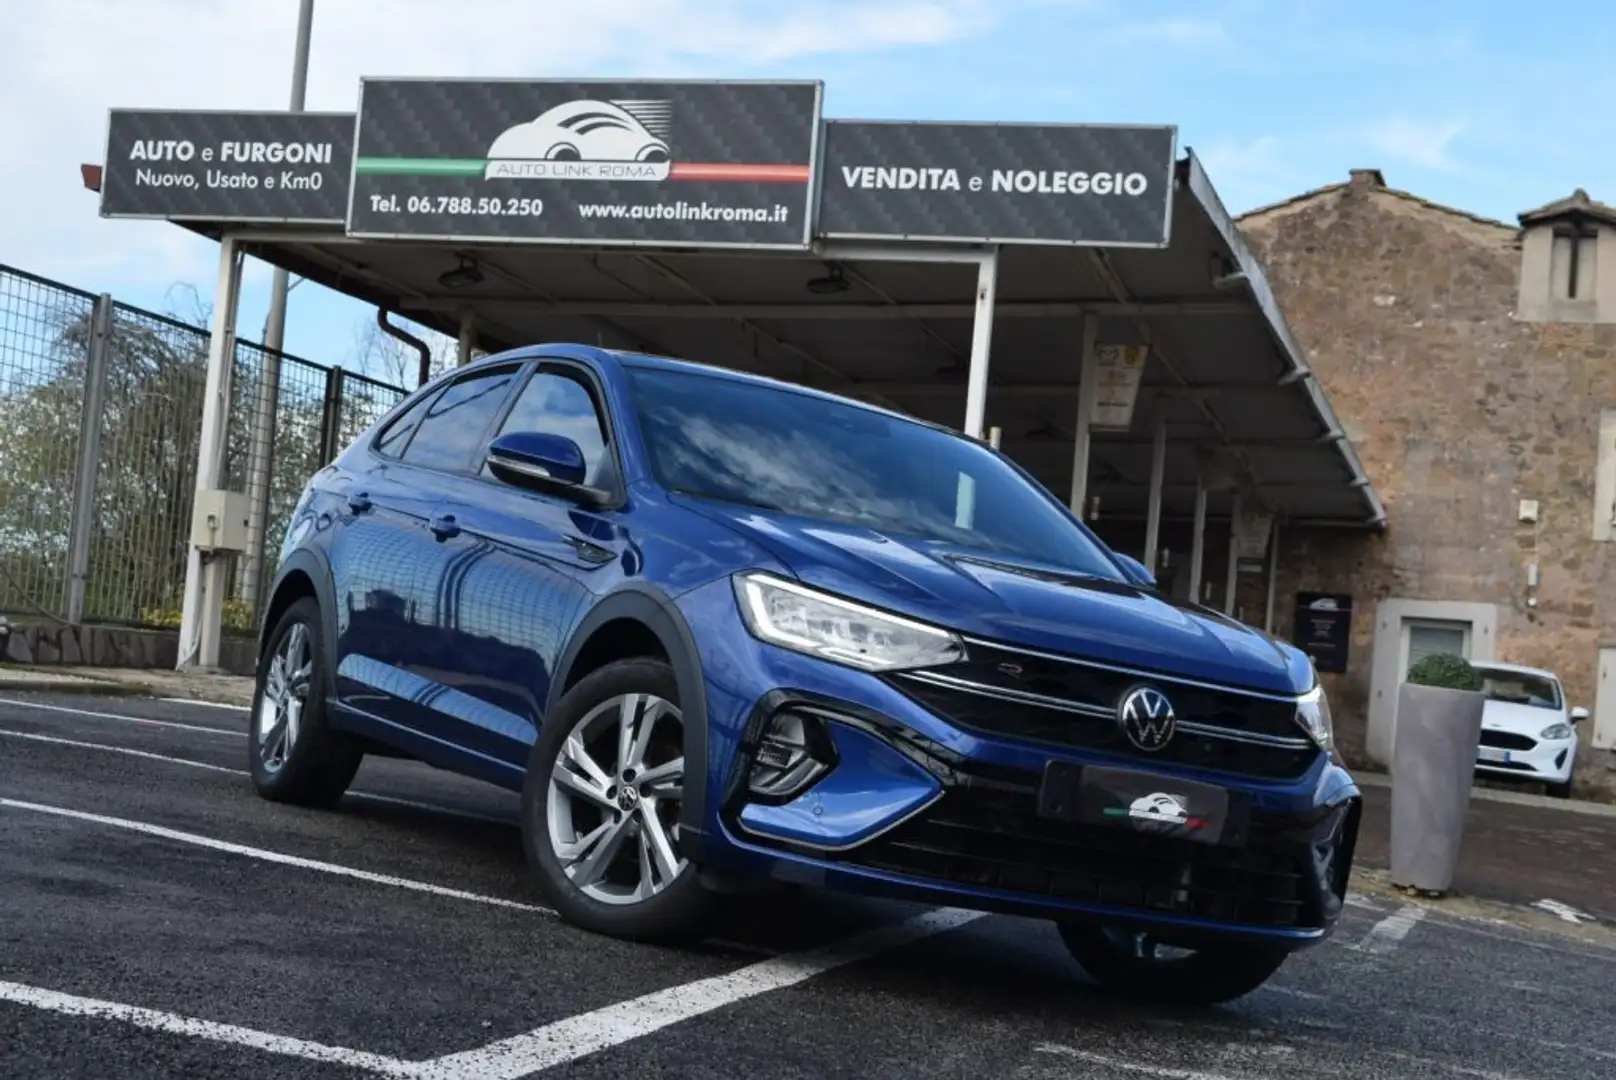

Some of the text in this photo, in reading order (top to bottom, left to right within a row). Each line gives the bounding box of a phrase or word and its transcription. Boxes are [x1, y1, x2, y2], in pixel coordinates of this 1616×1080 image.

[129, 140, 332, 164] AUTO e FURGONI
[135, 168, 323, 191] Nuovo, Usato e Km0
[496, 164, 657, 177] AUTO LINK ROMA
[841, 166, 1148, 196] VENDITA e NOLEGGIO
[370, 195, 543, 216] Tel. 06.788.50.250
[579, 200, 789, 222] www.autolinkroma.it
